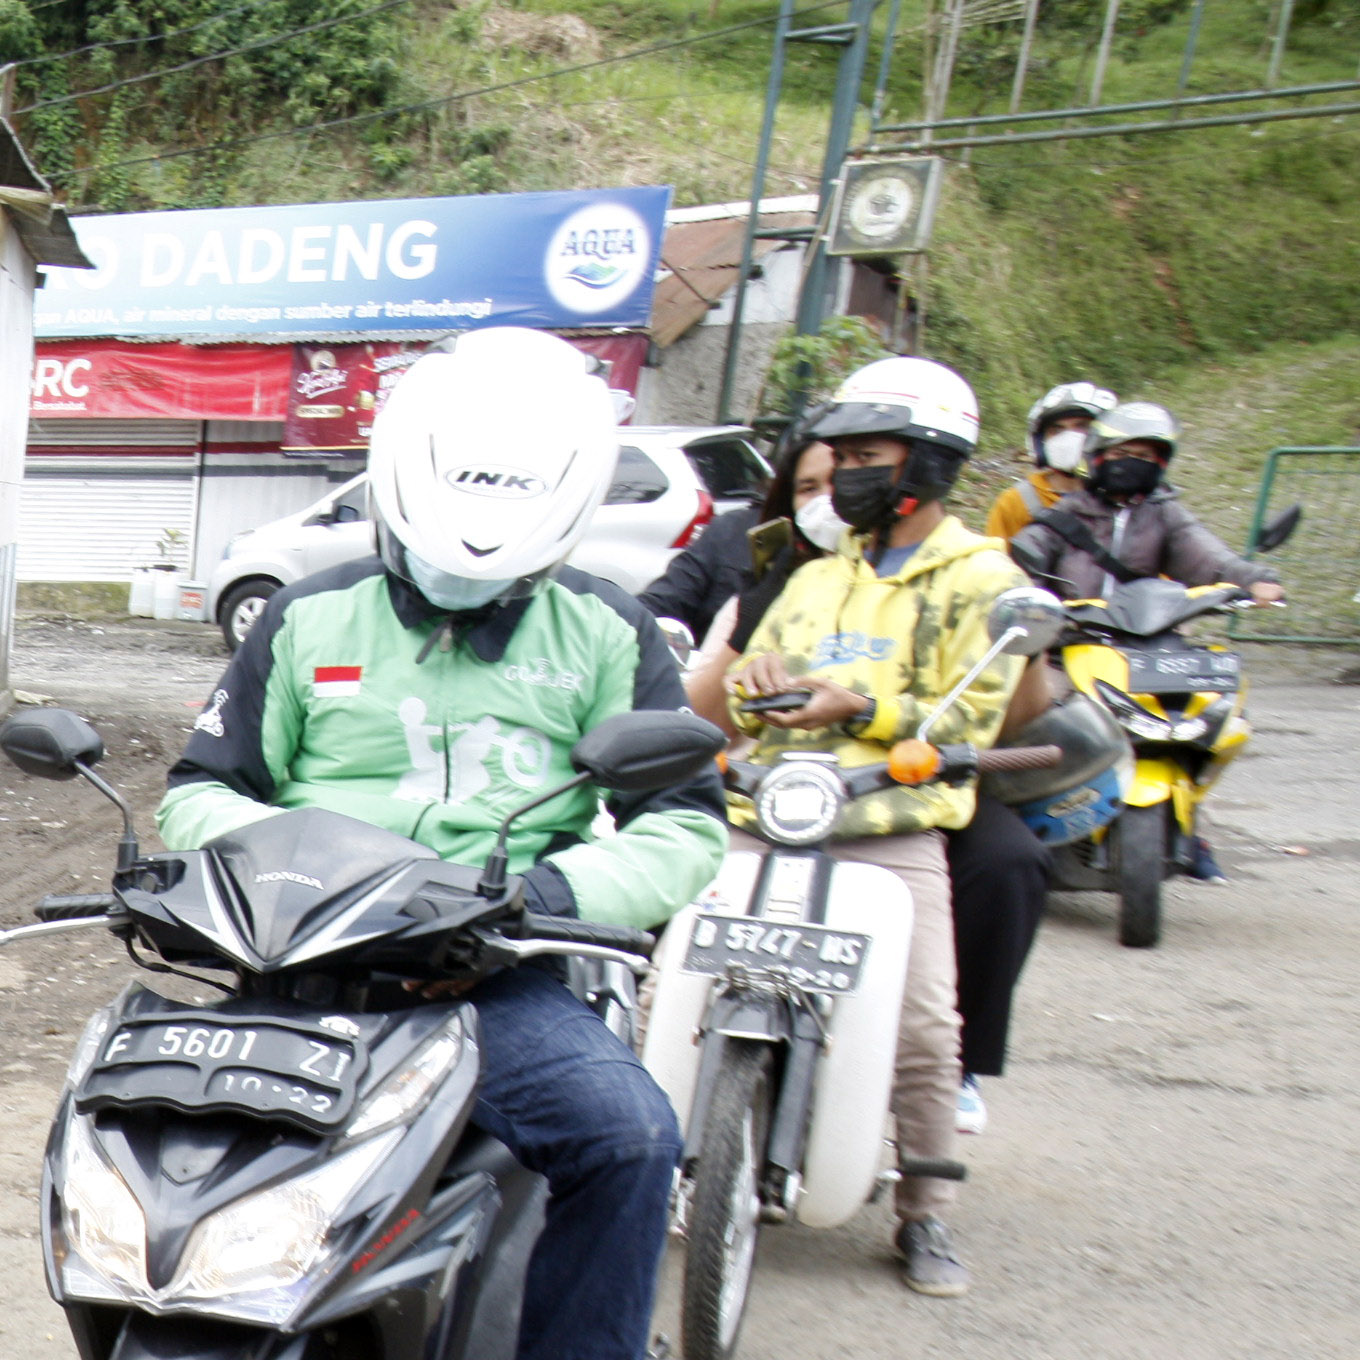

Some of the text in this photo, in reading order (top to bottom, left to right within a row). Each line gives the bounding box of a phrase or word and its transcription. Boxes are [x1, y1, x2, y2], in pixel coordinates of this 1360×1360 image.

[140, 219, 438, 288] DADENG
[560, 228, 637, 260] AQUA
[215, 304, 281, 323] dengan
[284, 301, 350, 320] sumber
[355, 300, 384, 318] air
[385, 298, 493, 319] terlindungi
[31, 358, 93, 398] RC
[455, 470, 537, 491] INK
[255, 870, 325, 890] HONDA
[104, 1032, 132, 1062] F
[158, 1026, 258, 1061] 5601
